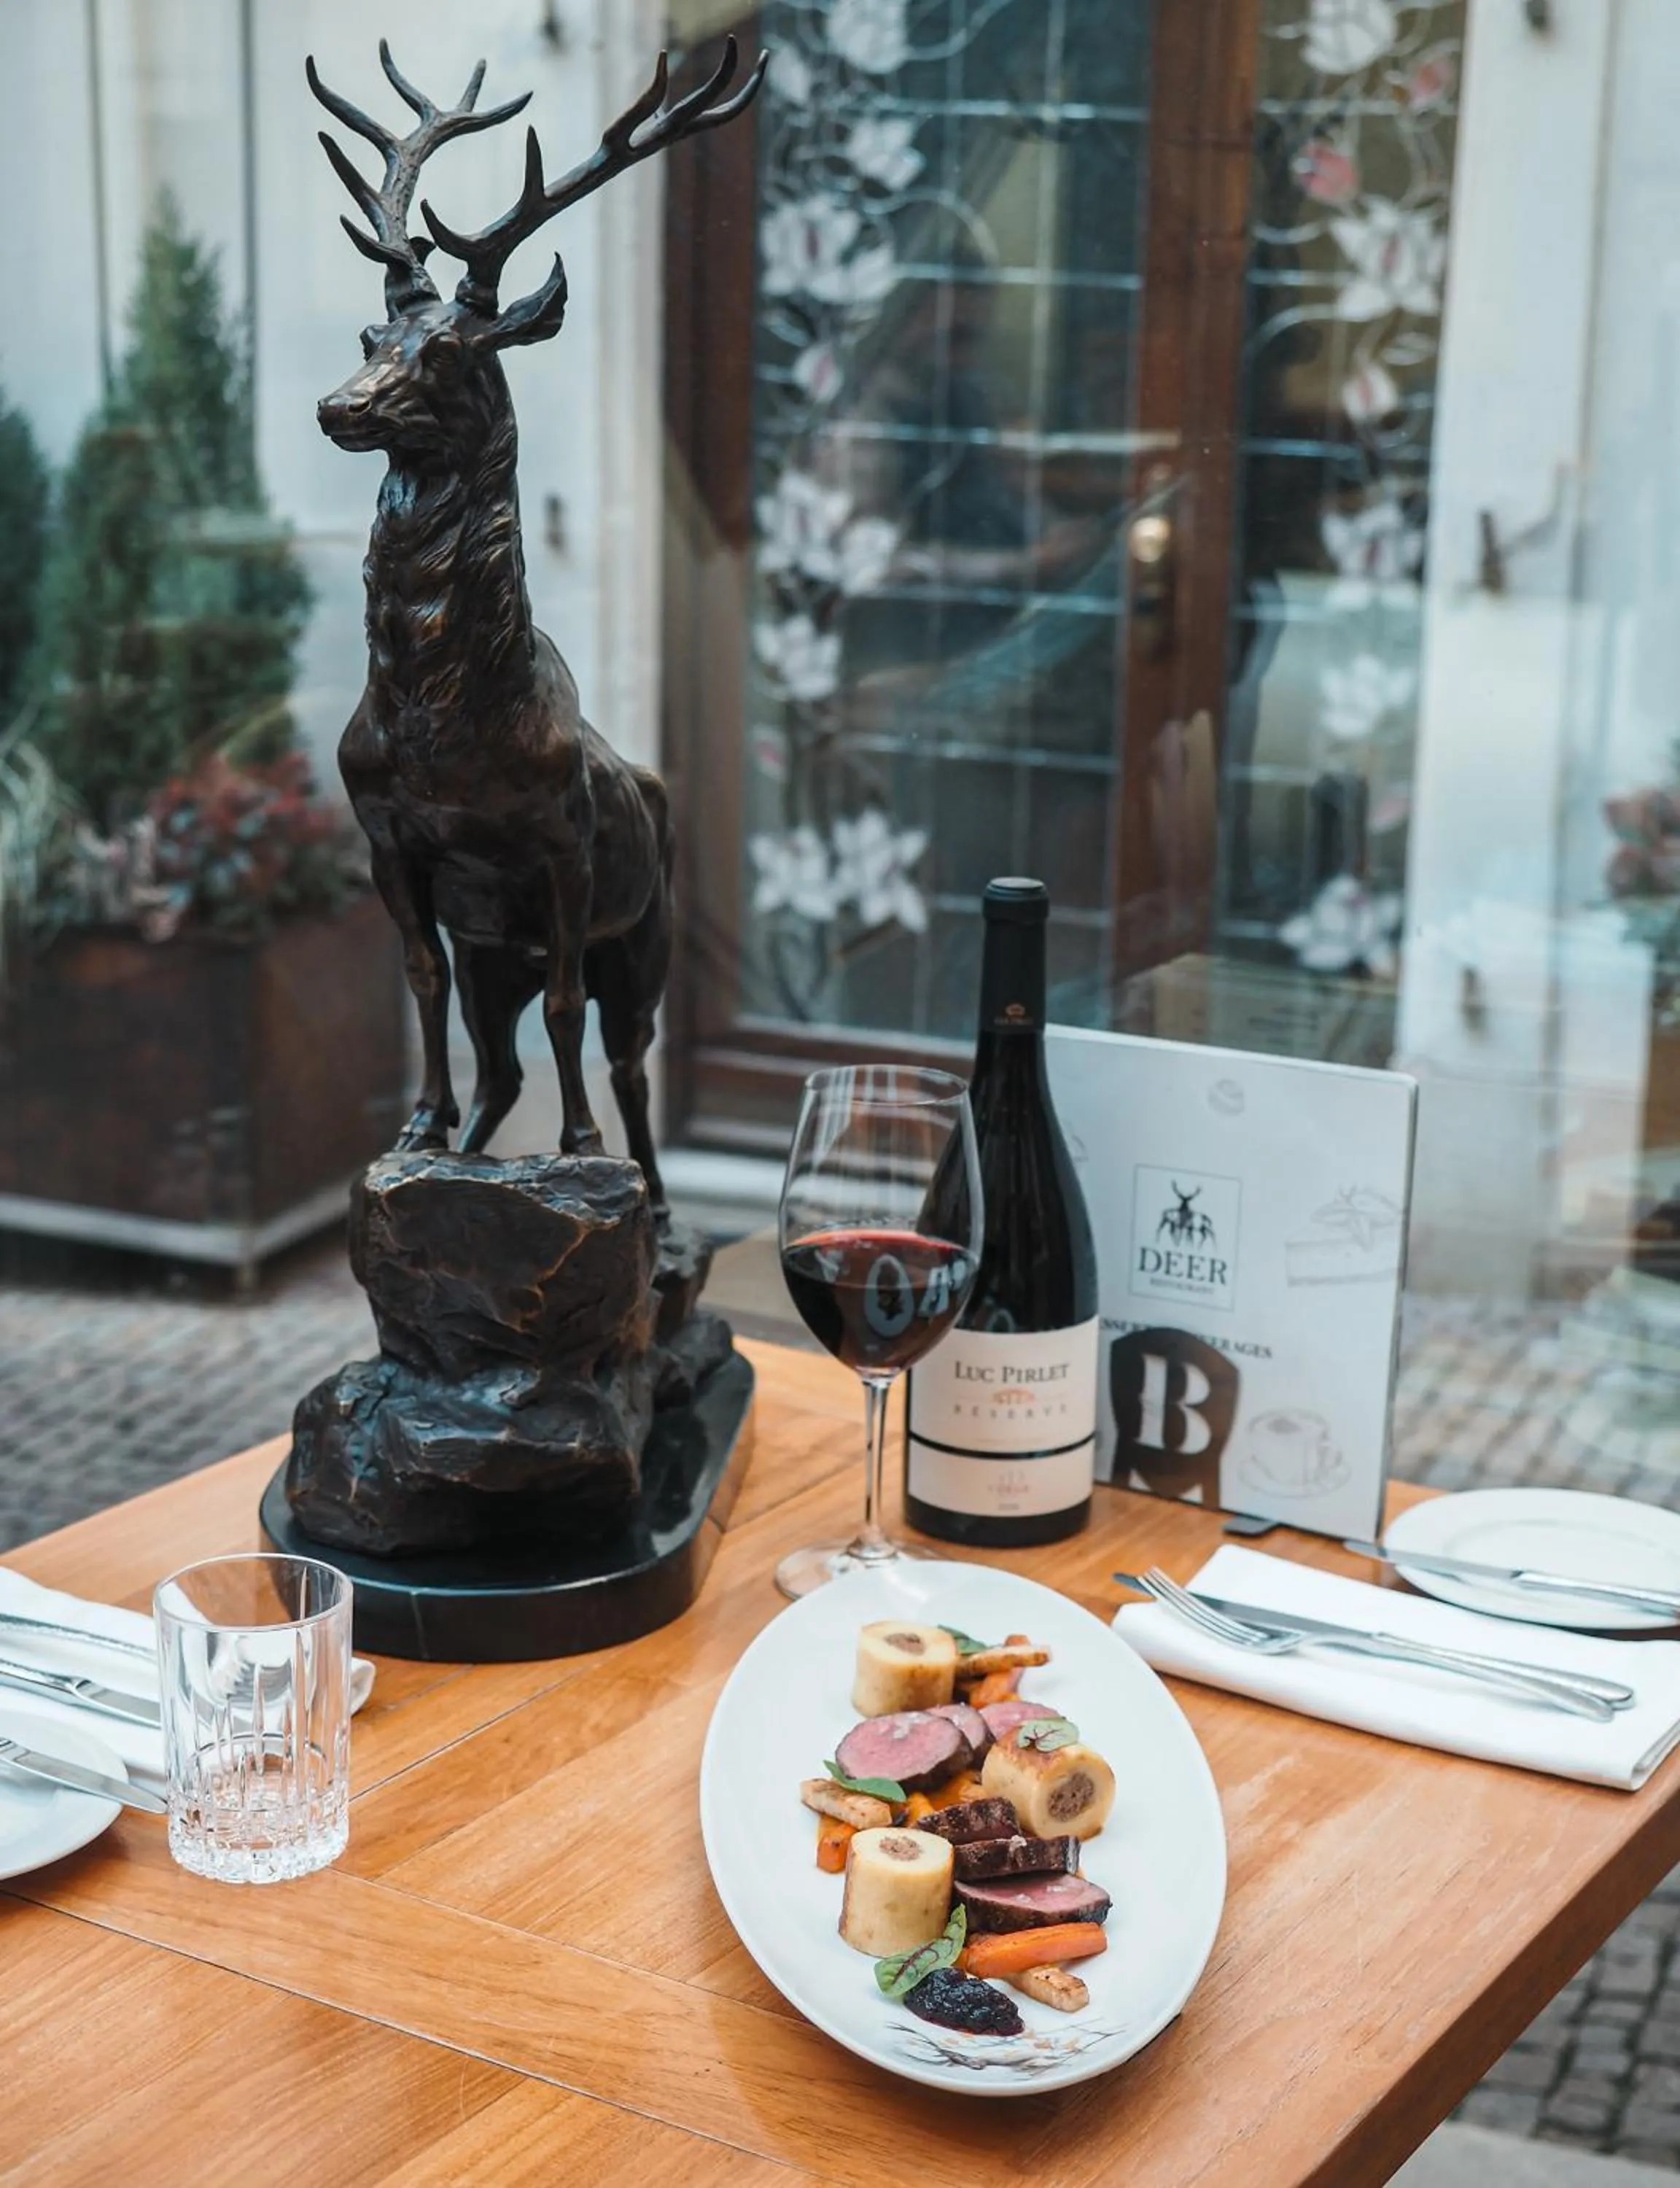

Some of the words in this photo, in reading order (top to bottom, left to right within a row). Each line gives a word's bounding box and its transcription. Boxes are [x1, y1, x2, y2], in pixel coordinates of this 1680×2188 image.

[1138, 1246, 1228, 1286] DEER
[954, 1359, 995, 1383] LUC
[1002, 1362, 1070, 1384] PIRLET
